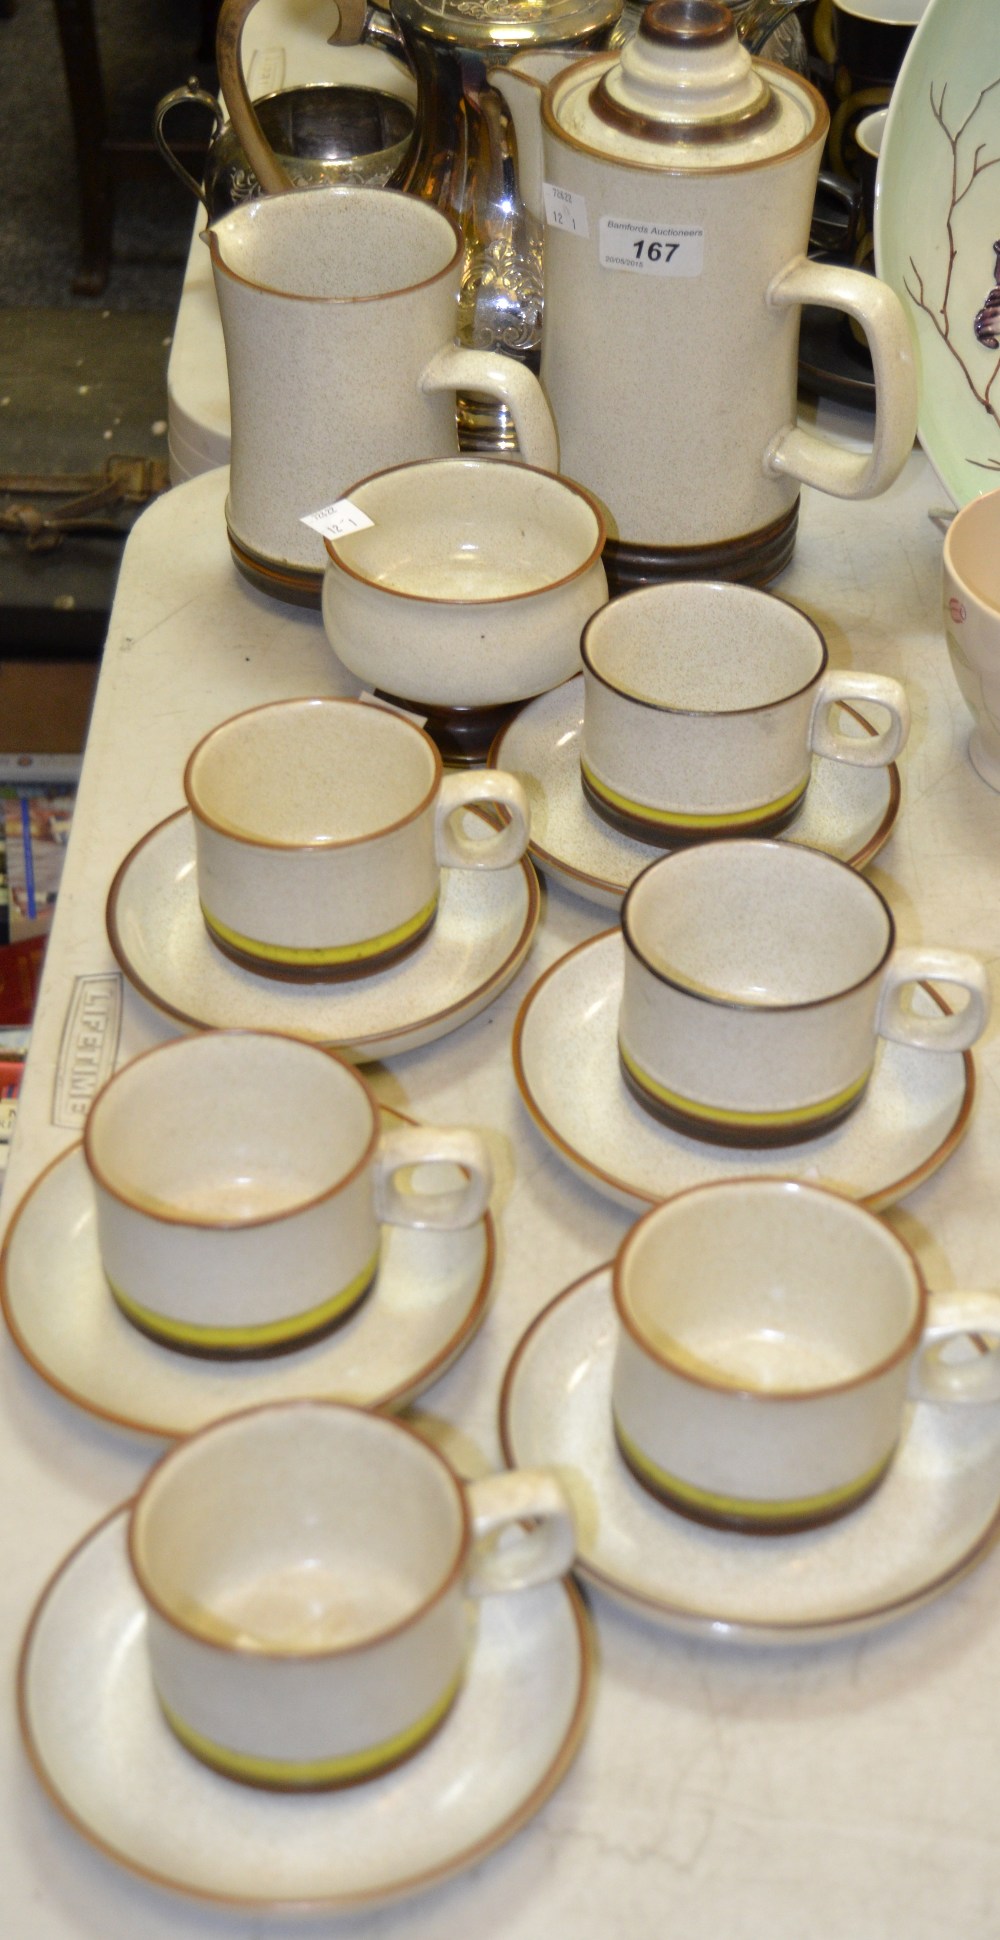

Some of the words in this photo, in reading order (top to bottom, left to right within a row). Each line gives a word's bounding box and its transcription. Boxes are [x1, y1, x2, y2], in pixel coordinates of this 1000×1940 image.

[553, 210, 563, 225] 12
[572, 218, 576, 230] 1
[607, 220, 649, 234] Bamfords
[651, 226, 704, 237] Auctioneers
[633, 239, 680, 263] 167
[327, 524, 343, 534] 12
[68, 988, 114, 1116] LIFETIME
